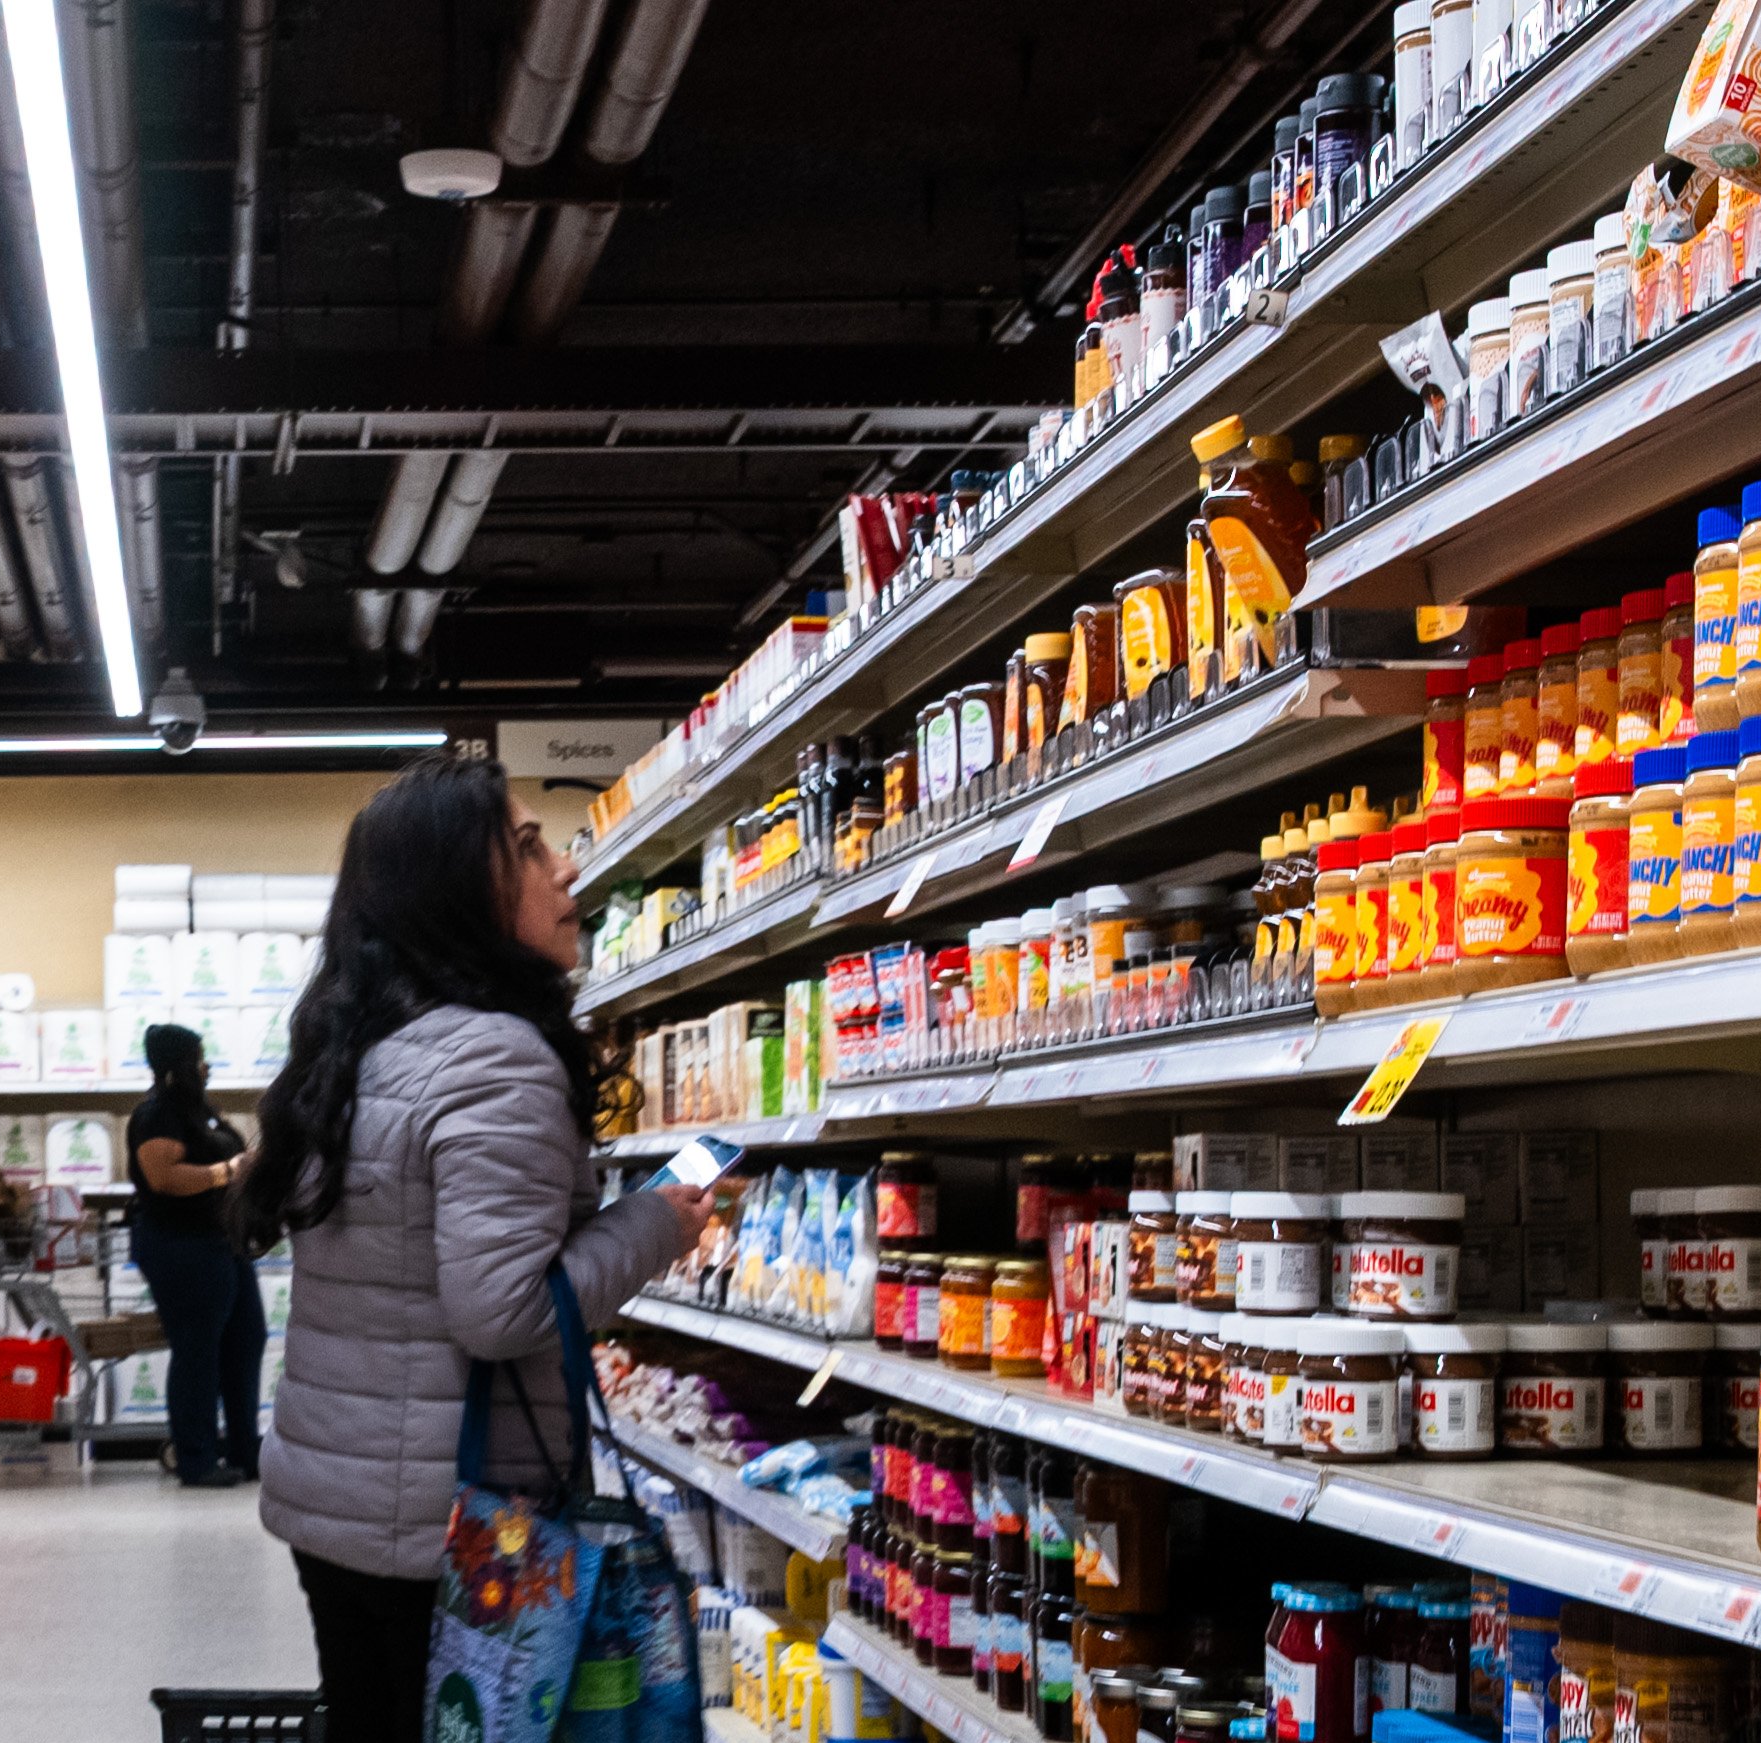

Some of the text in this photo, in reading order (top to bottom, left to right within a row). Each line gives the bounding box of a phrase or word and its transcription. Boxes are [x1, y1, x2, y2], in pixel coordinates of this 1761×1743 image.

[1729, 82, 1748, 102] 10
[1254, 293, 1271, 322] 2
[940, 554, 955, 578] 3
[453, 738, 616, 762] 3B Spices
[1630, 857, 1681, 887] NCHY
[1456, 895, 1529, 932] Creamy
[1463, 917, 1507, 934] peanut
[1464, 930, 1507, 945] butter
[1302, 1384, 1356, 1415] utella
[1504, 1382, 1575, 1411] utella
[1561, 1680, 1585, 1710] PPY
